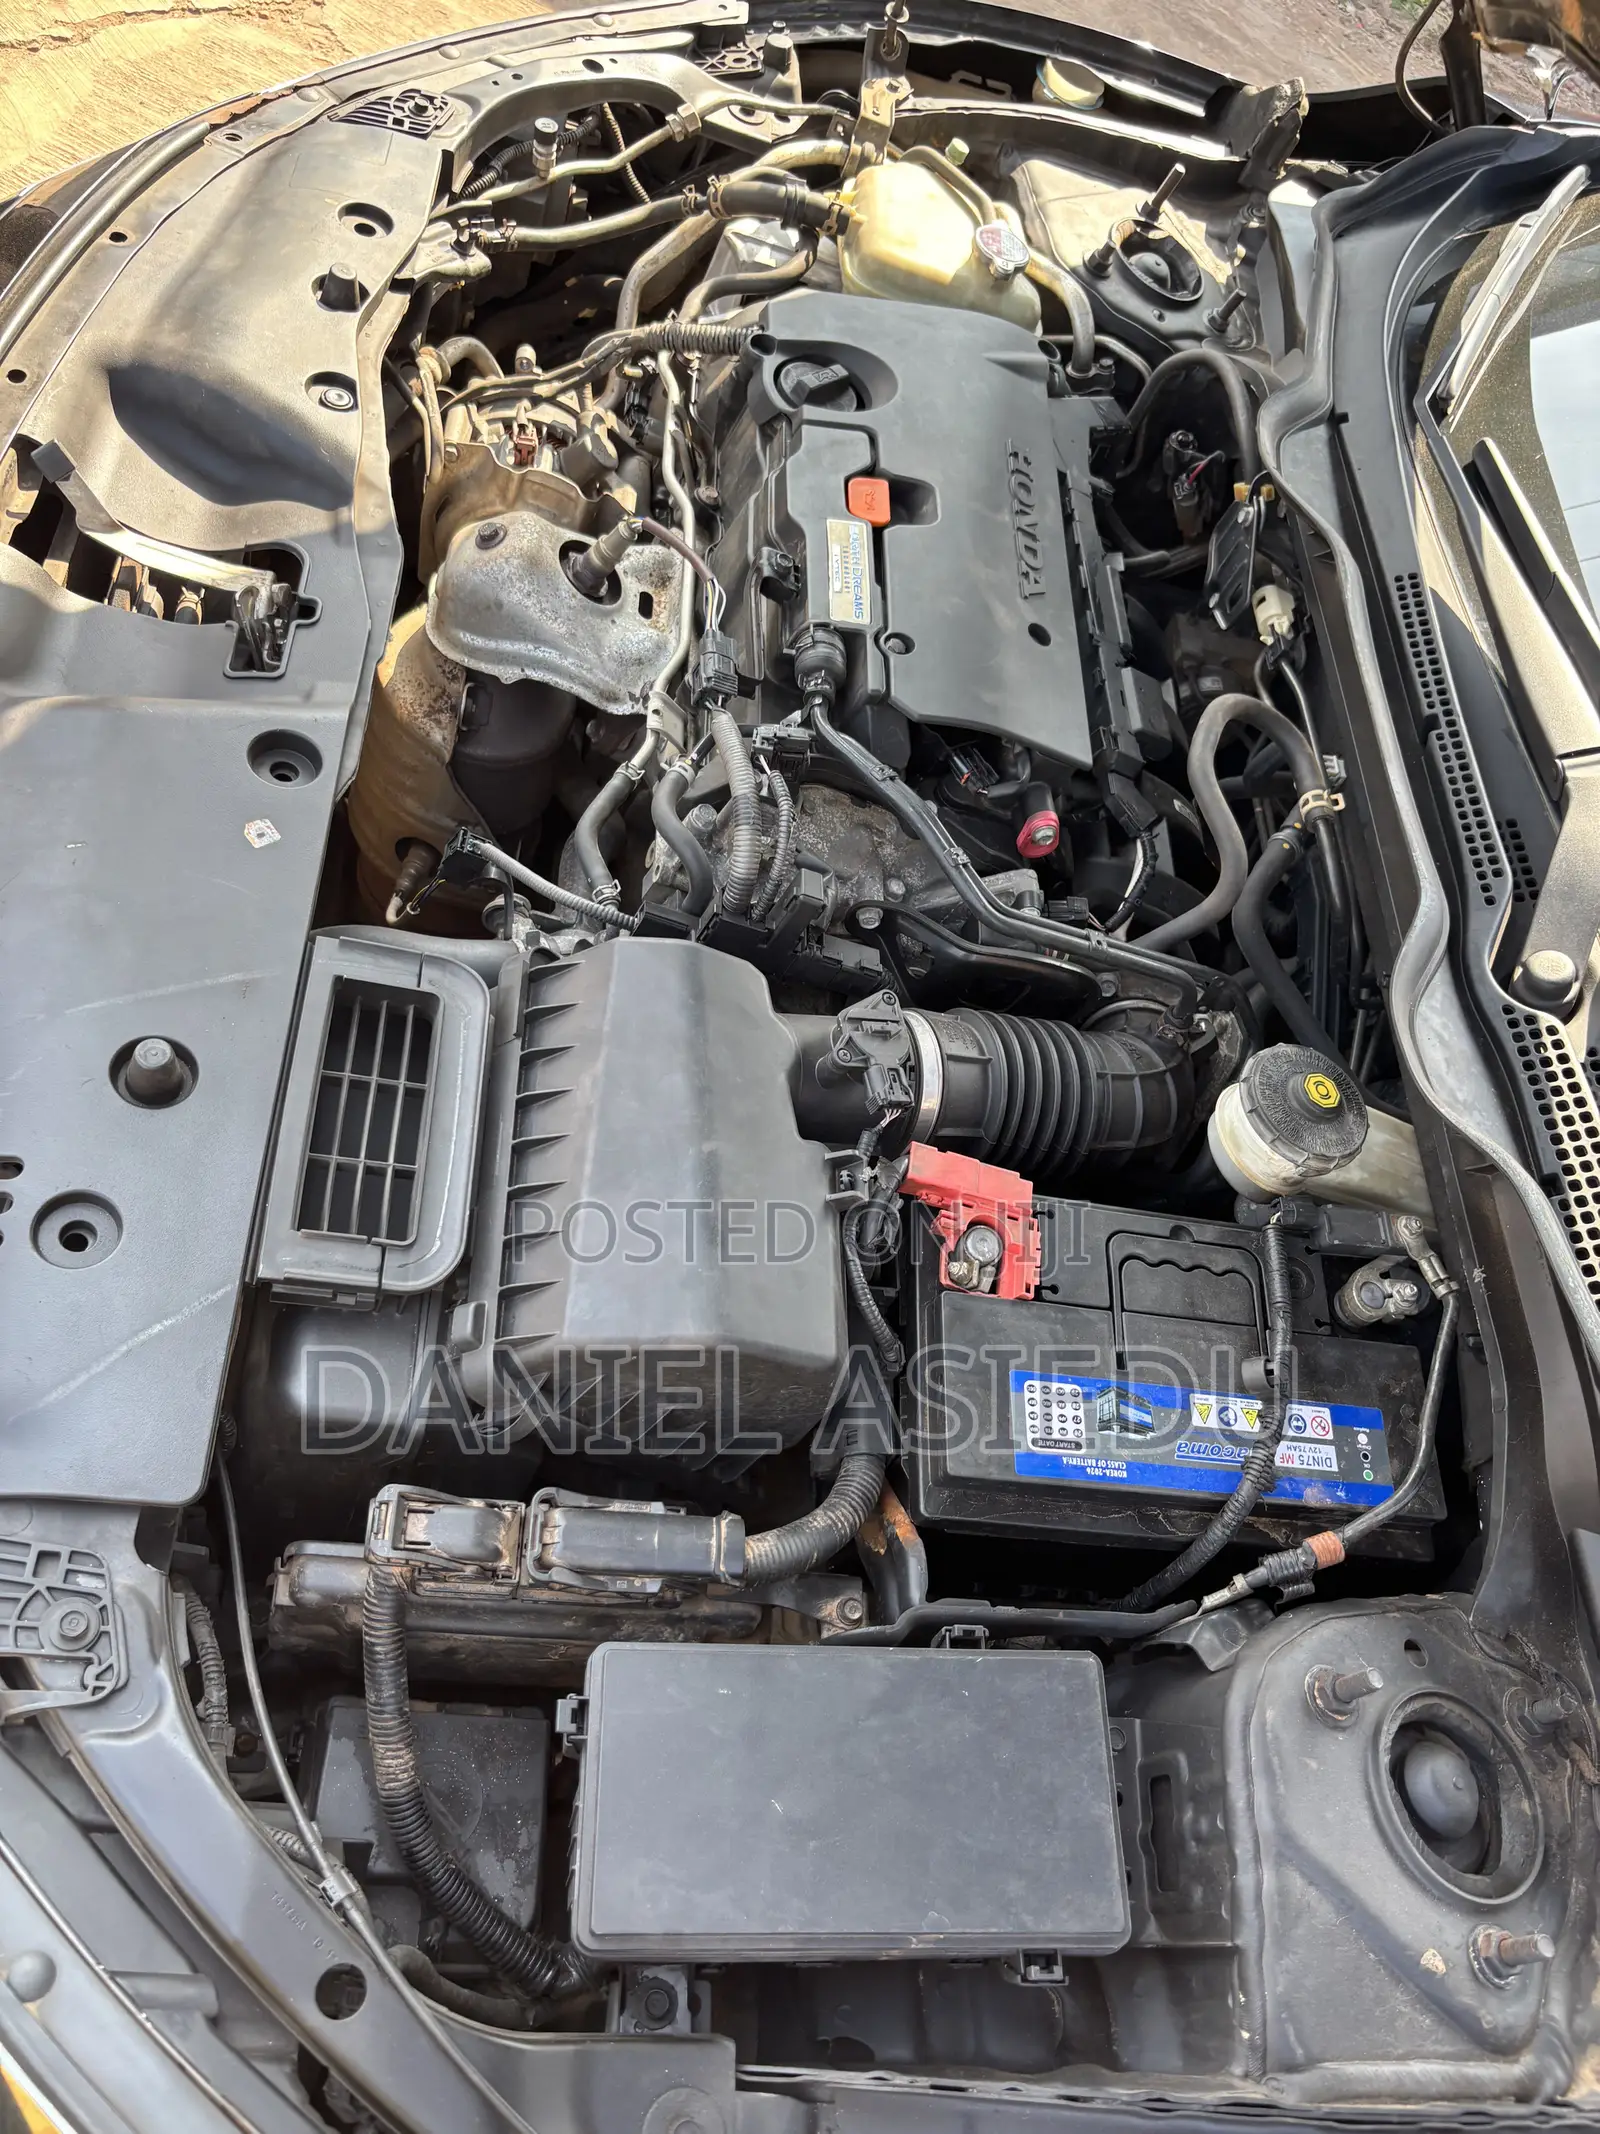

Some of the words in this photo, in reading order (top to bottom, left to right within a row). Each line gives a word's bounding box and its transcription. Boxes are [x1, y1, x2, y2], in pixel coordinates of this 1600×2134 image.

[1006, 438, 1047, 599] HONDA
[851, 567, 864, 620] DREAMS
[1037, 1439, 1055, 1447] DATE
[1055, 1440, 1076, 1448] START
[1175, 1441, 1252, 1462] acoma
[1286, 1444, 1306, 1453] 75AH
[1308, 1446, 1322, 1454] 12V
[1097, 1459, 1107, 1467] OF
[1279, 1452, 1295, 1465] MF
[1298, 1454, 1333, 1468] DIN75
[1106, 1460, 1126, 1468] CLASS
[1086, 1467, 1128, 1478] KOREA-2026
